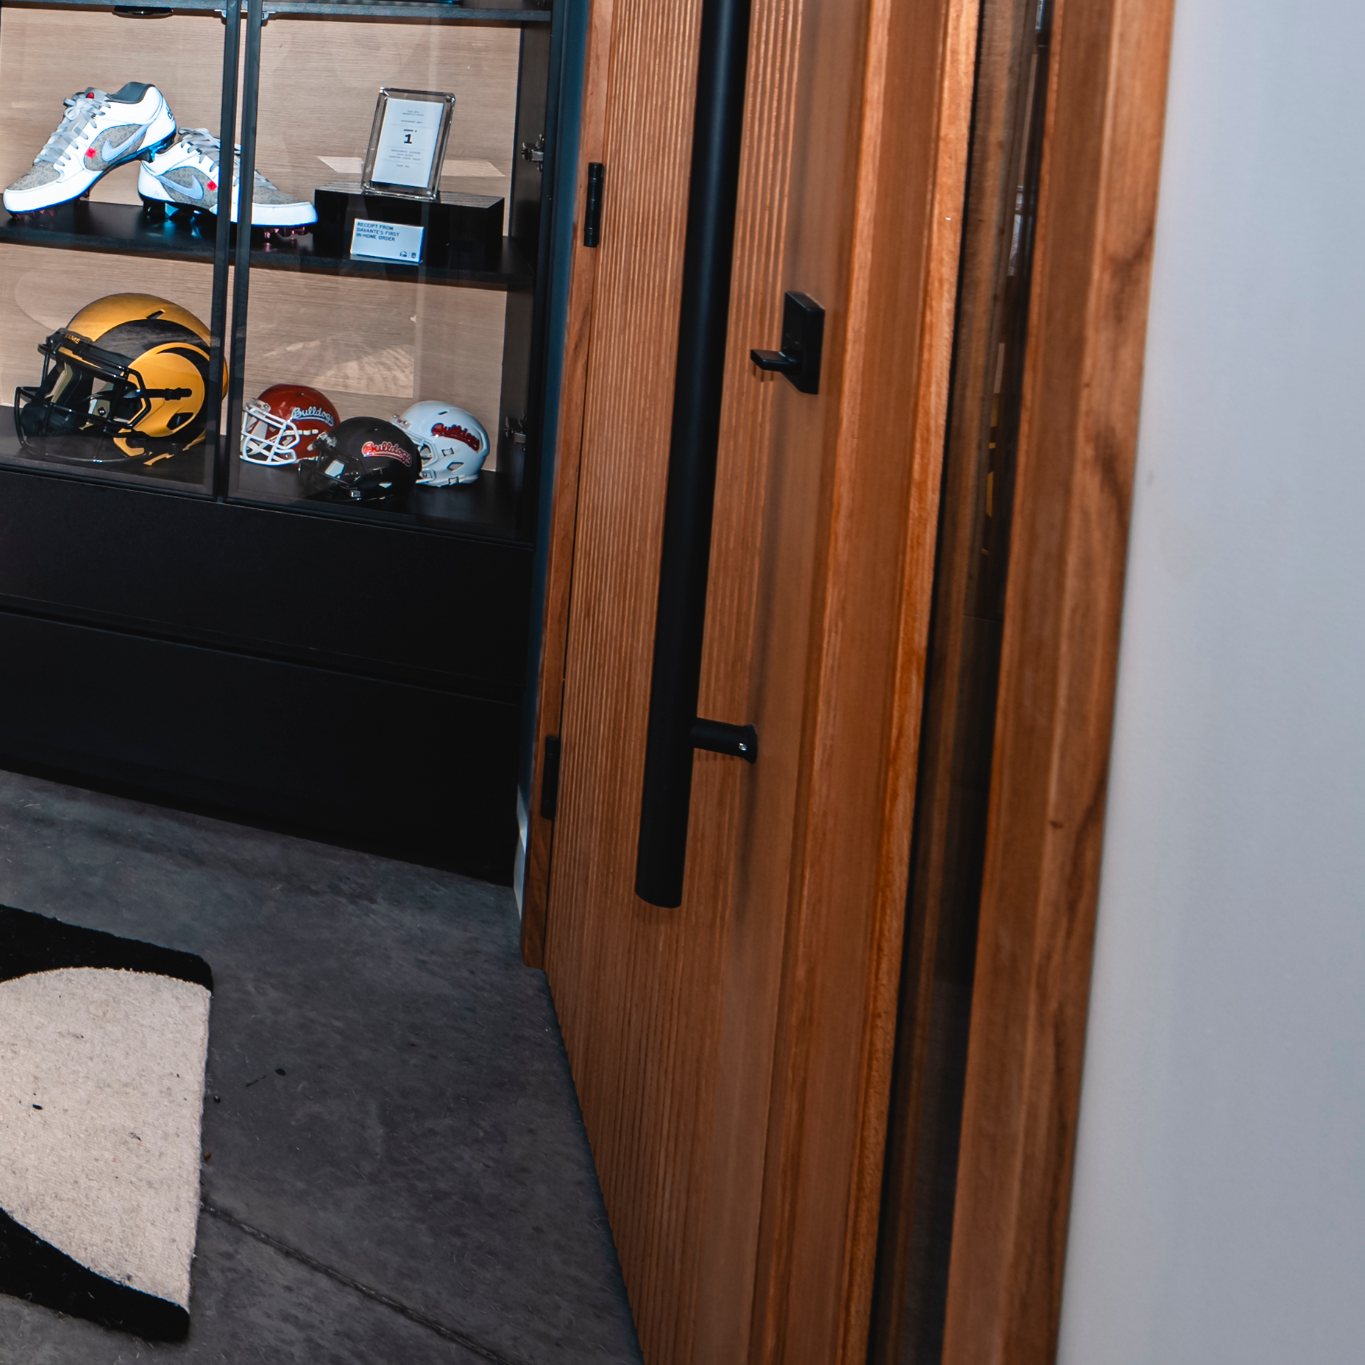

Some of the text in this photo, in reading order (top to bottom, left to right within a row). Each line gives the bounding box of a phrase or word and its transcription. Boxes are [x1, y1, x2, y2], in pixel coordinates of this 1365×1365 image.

[404, 134, 412, 144] 1
[292, 406, 334, 426] Bulldogs
[431, 423, 480, 452] Bulldogs
[361, 441, 412, 467] Bulldogs
